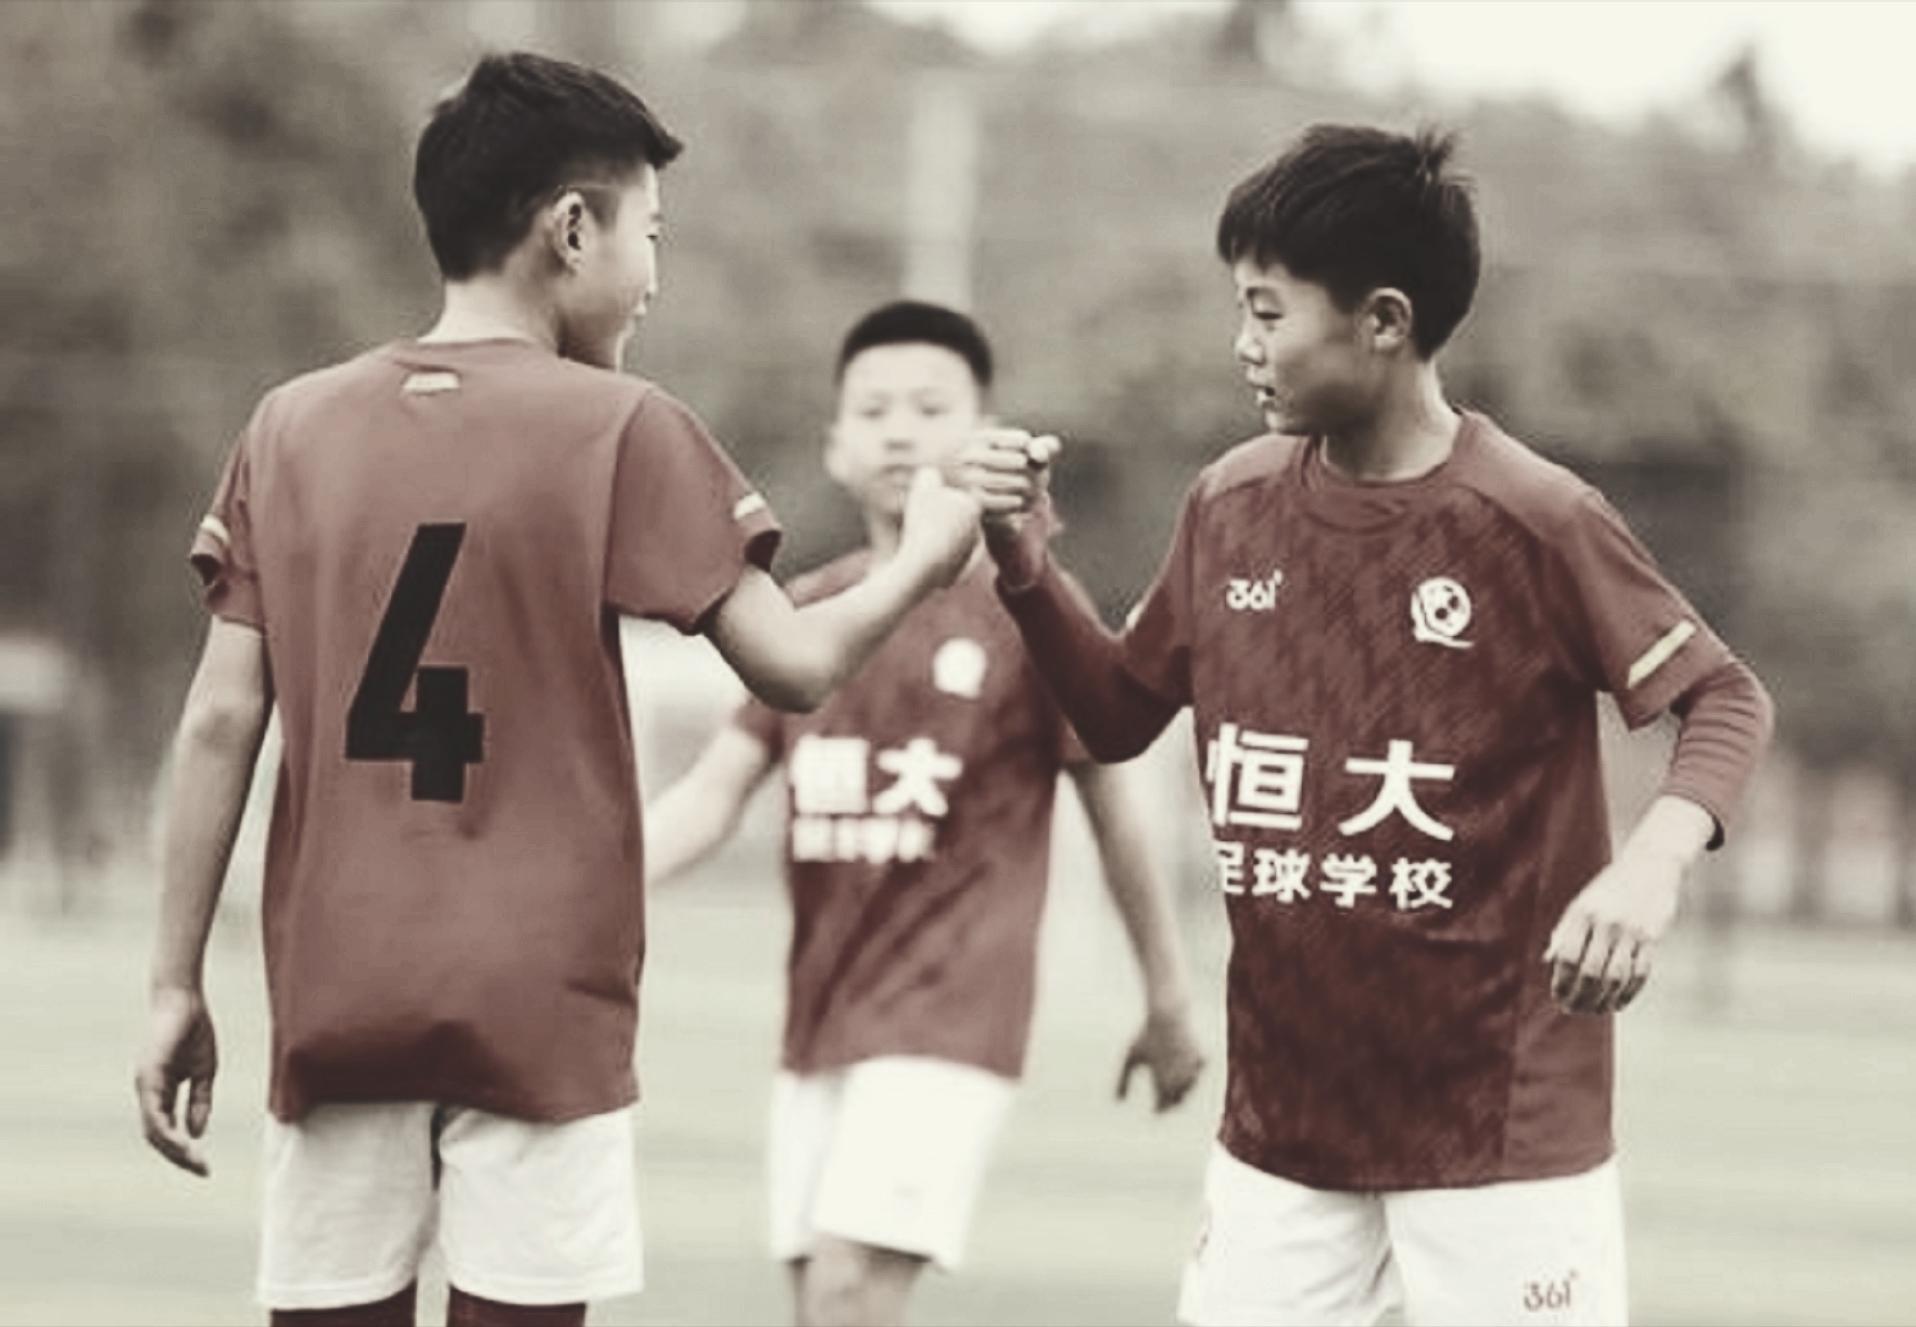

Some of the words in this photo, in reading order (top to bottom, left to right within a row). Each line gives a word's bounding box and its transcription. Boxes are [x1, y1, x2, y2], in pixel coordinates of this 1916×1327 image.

[345, 522, 485, 803] 4
[788, 734, 963, 818] 大
[1205, 722, 1455, 841] 恒大
